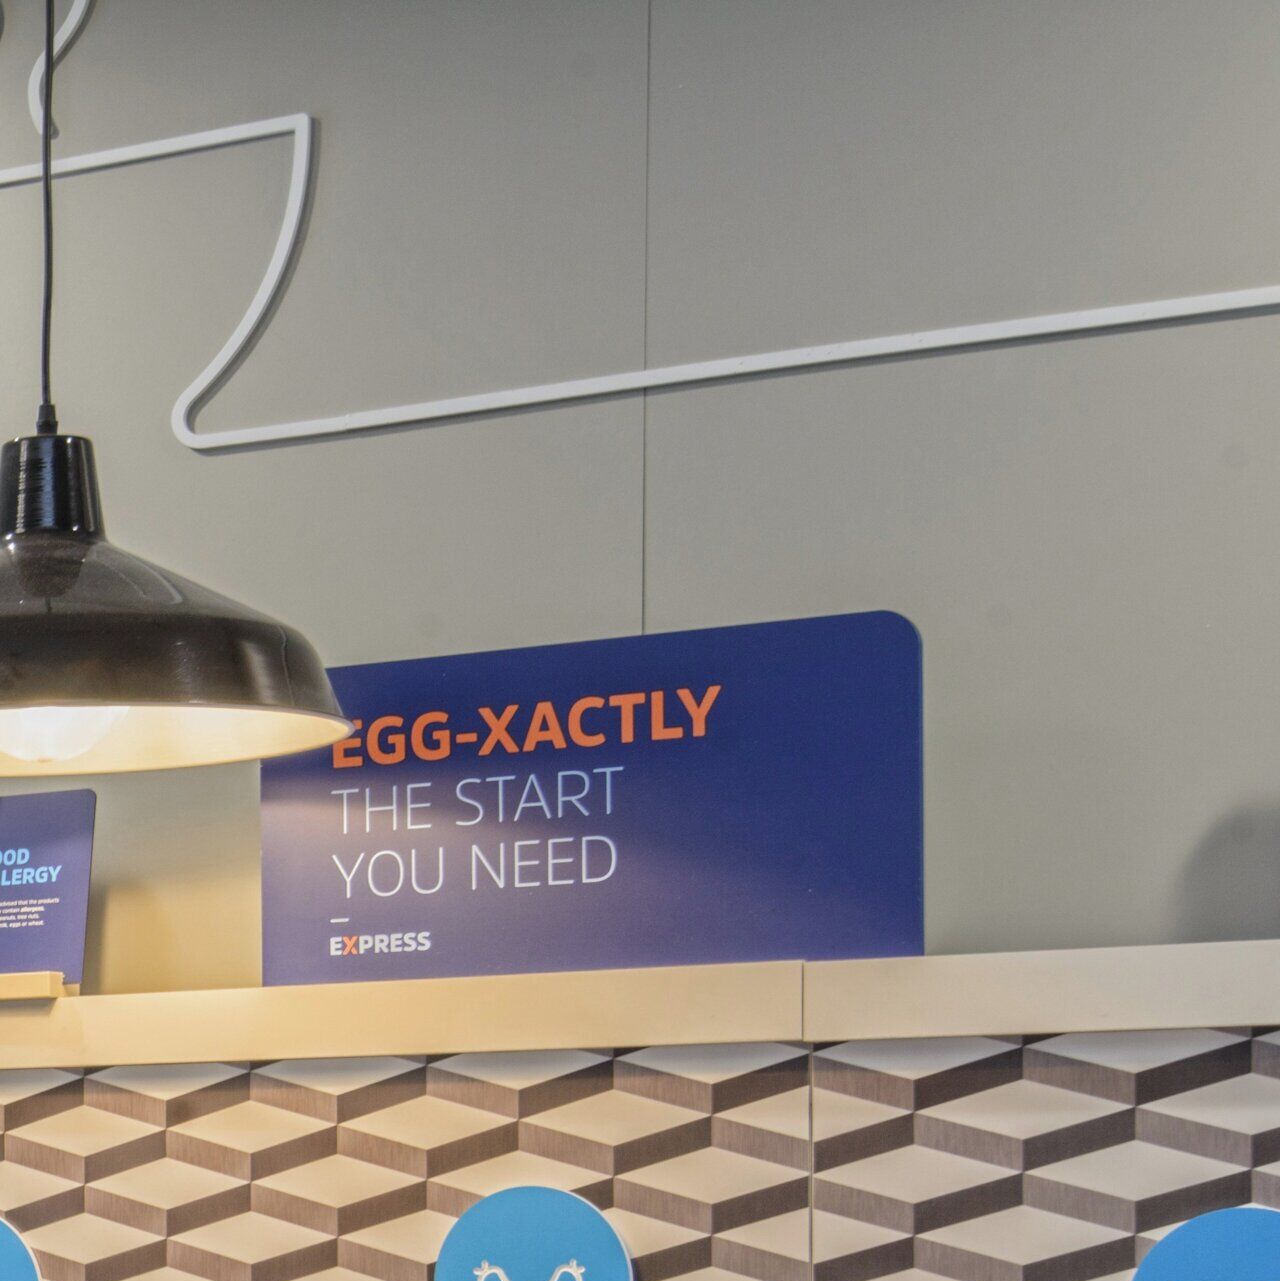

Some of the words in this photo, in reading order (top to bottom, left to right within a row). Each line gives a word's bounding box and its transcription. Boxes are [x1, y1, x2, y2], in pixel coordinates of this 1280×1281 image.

[332, 684, 722, 769] EGG-XACTLY
[331, 781, 433, 835] THE
[455, 766, 625, 827] START
[332, 848, 444, 899] YOU
[471, 835, 618, 890] NEED
[329, 930, 432, 957] EXPRESS
